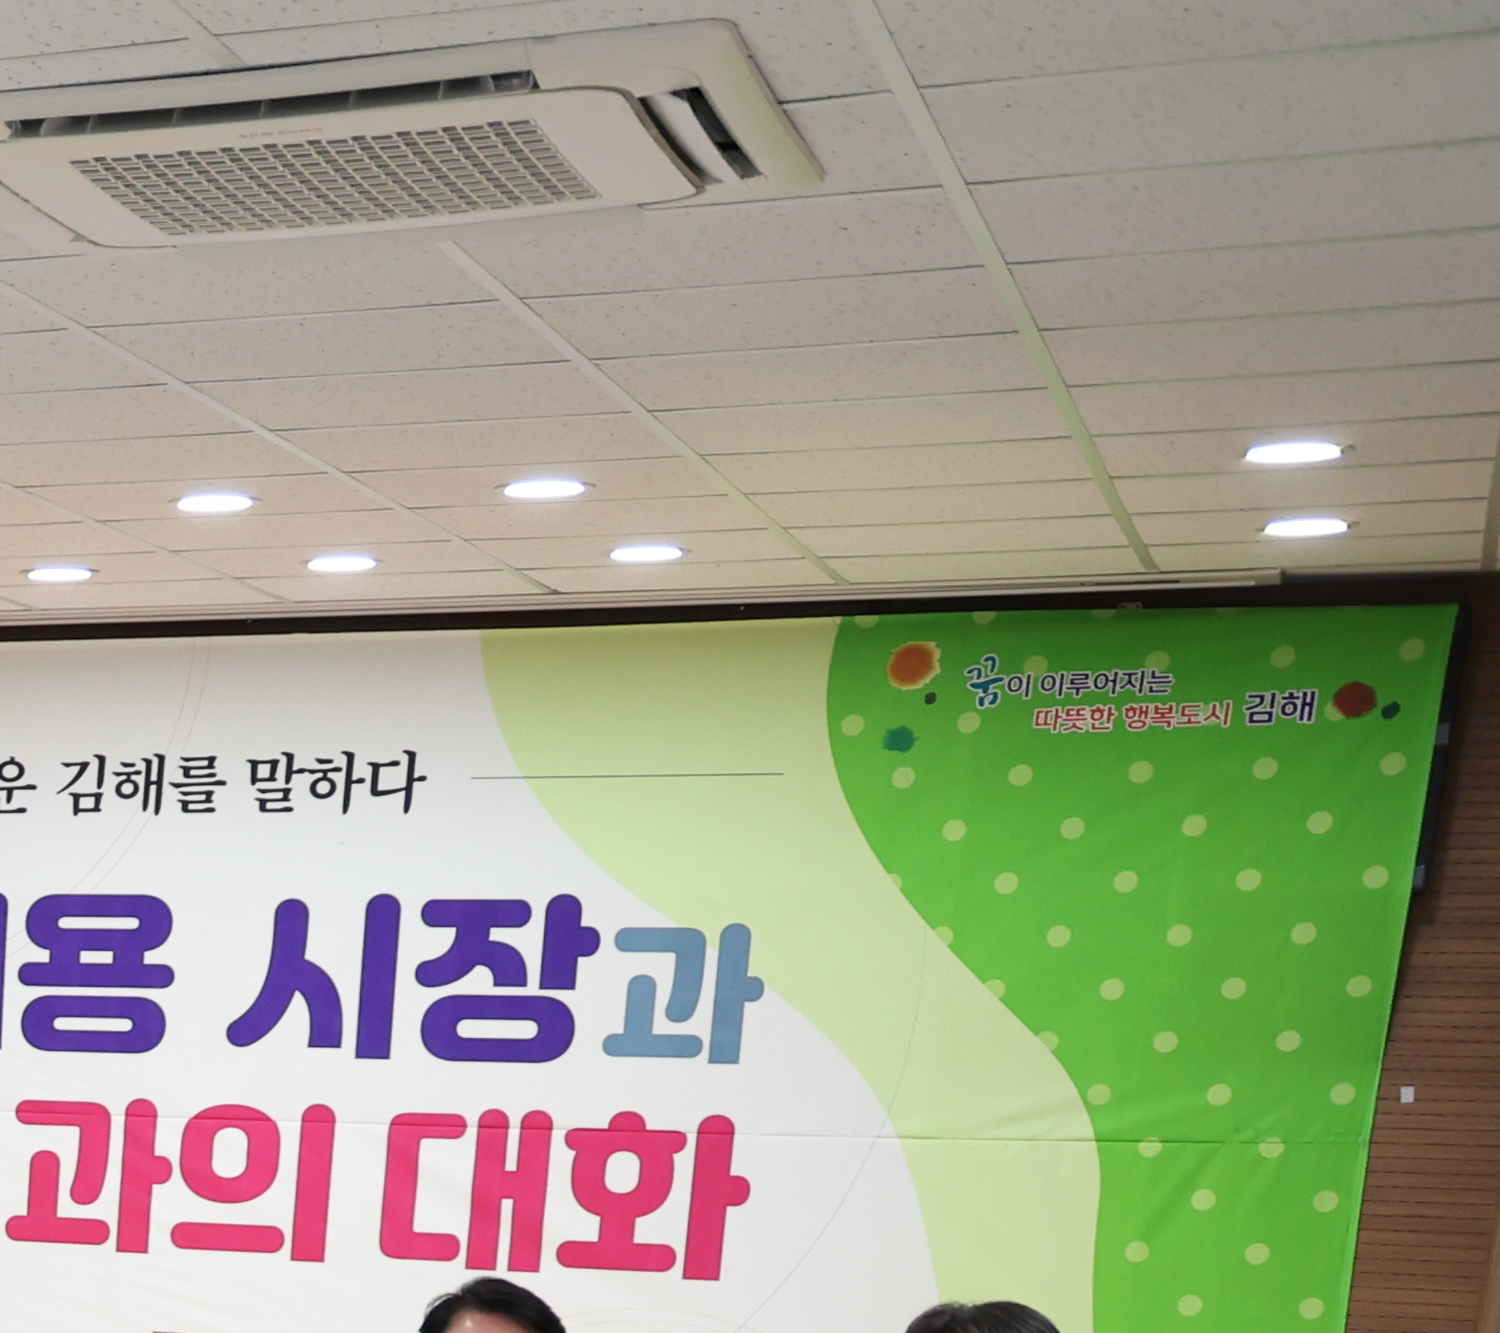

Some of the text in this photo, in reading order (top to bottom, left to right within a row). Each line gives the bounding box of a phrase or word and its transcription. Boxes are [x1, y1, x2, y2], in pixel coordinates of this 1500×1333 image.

[965, 654, 1174, 708] 꿈이 이루어지는
[1033, 689, 1316, 732] 따뜻한 행복도시 김해
[55, 753, 226, 817] 김해를
[247, 751, 426, 816] 말하다
[226, 893, 763, 1065] 시장과
[378, 1108, 750, 1281] 대화
